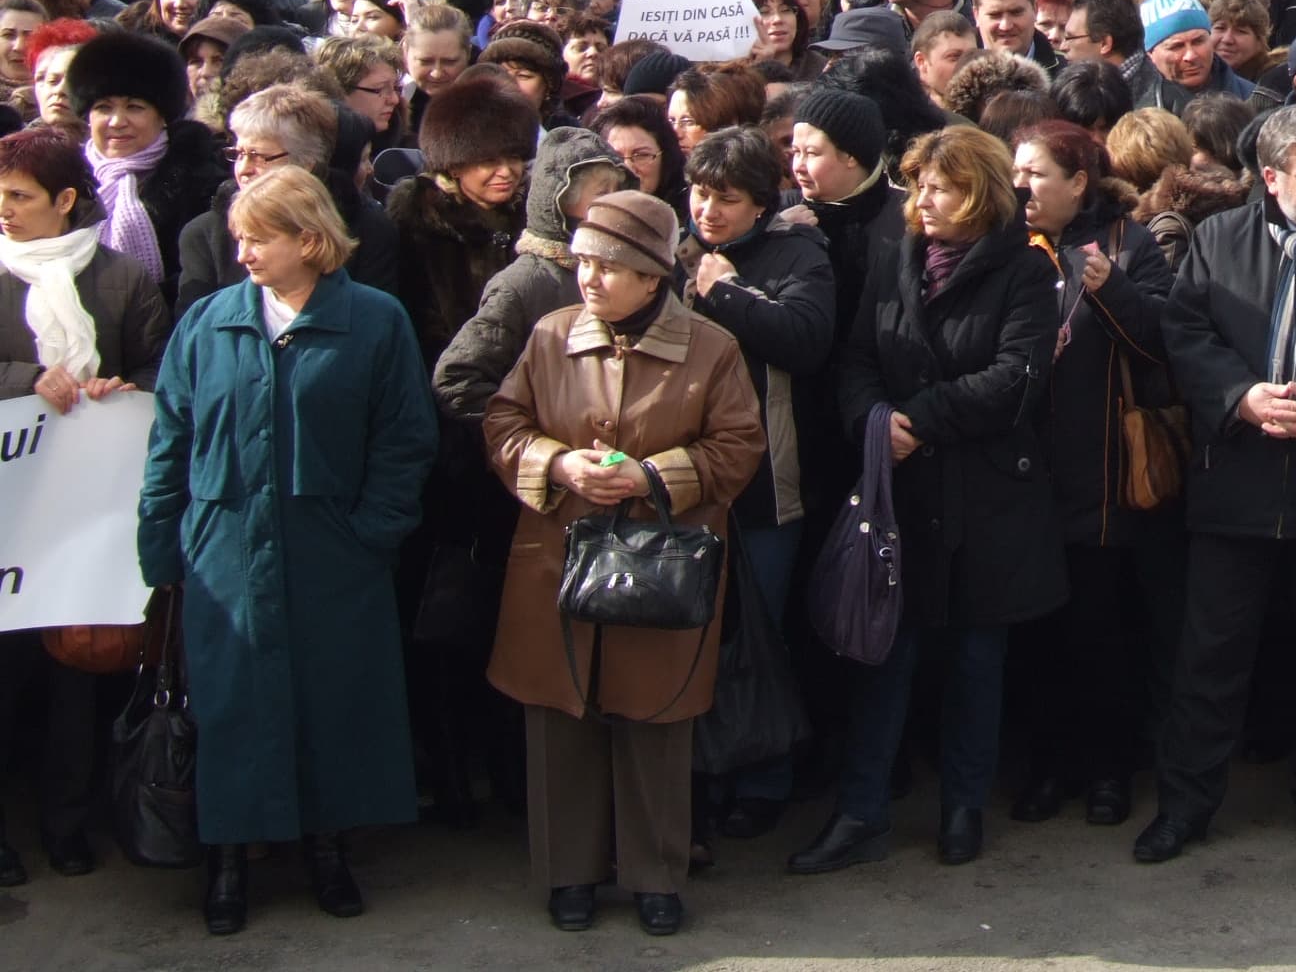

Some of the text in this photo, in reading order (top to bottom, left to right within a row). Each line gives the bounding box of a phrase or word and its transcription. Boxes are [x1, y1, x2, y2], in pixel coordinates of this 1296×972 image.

[682, 8, 707, 21] DIN
[711, 1, 744, 18] CASĂ
[628, 25, 750, 43] DACĂ VĂ PASĂ !!!
